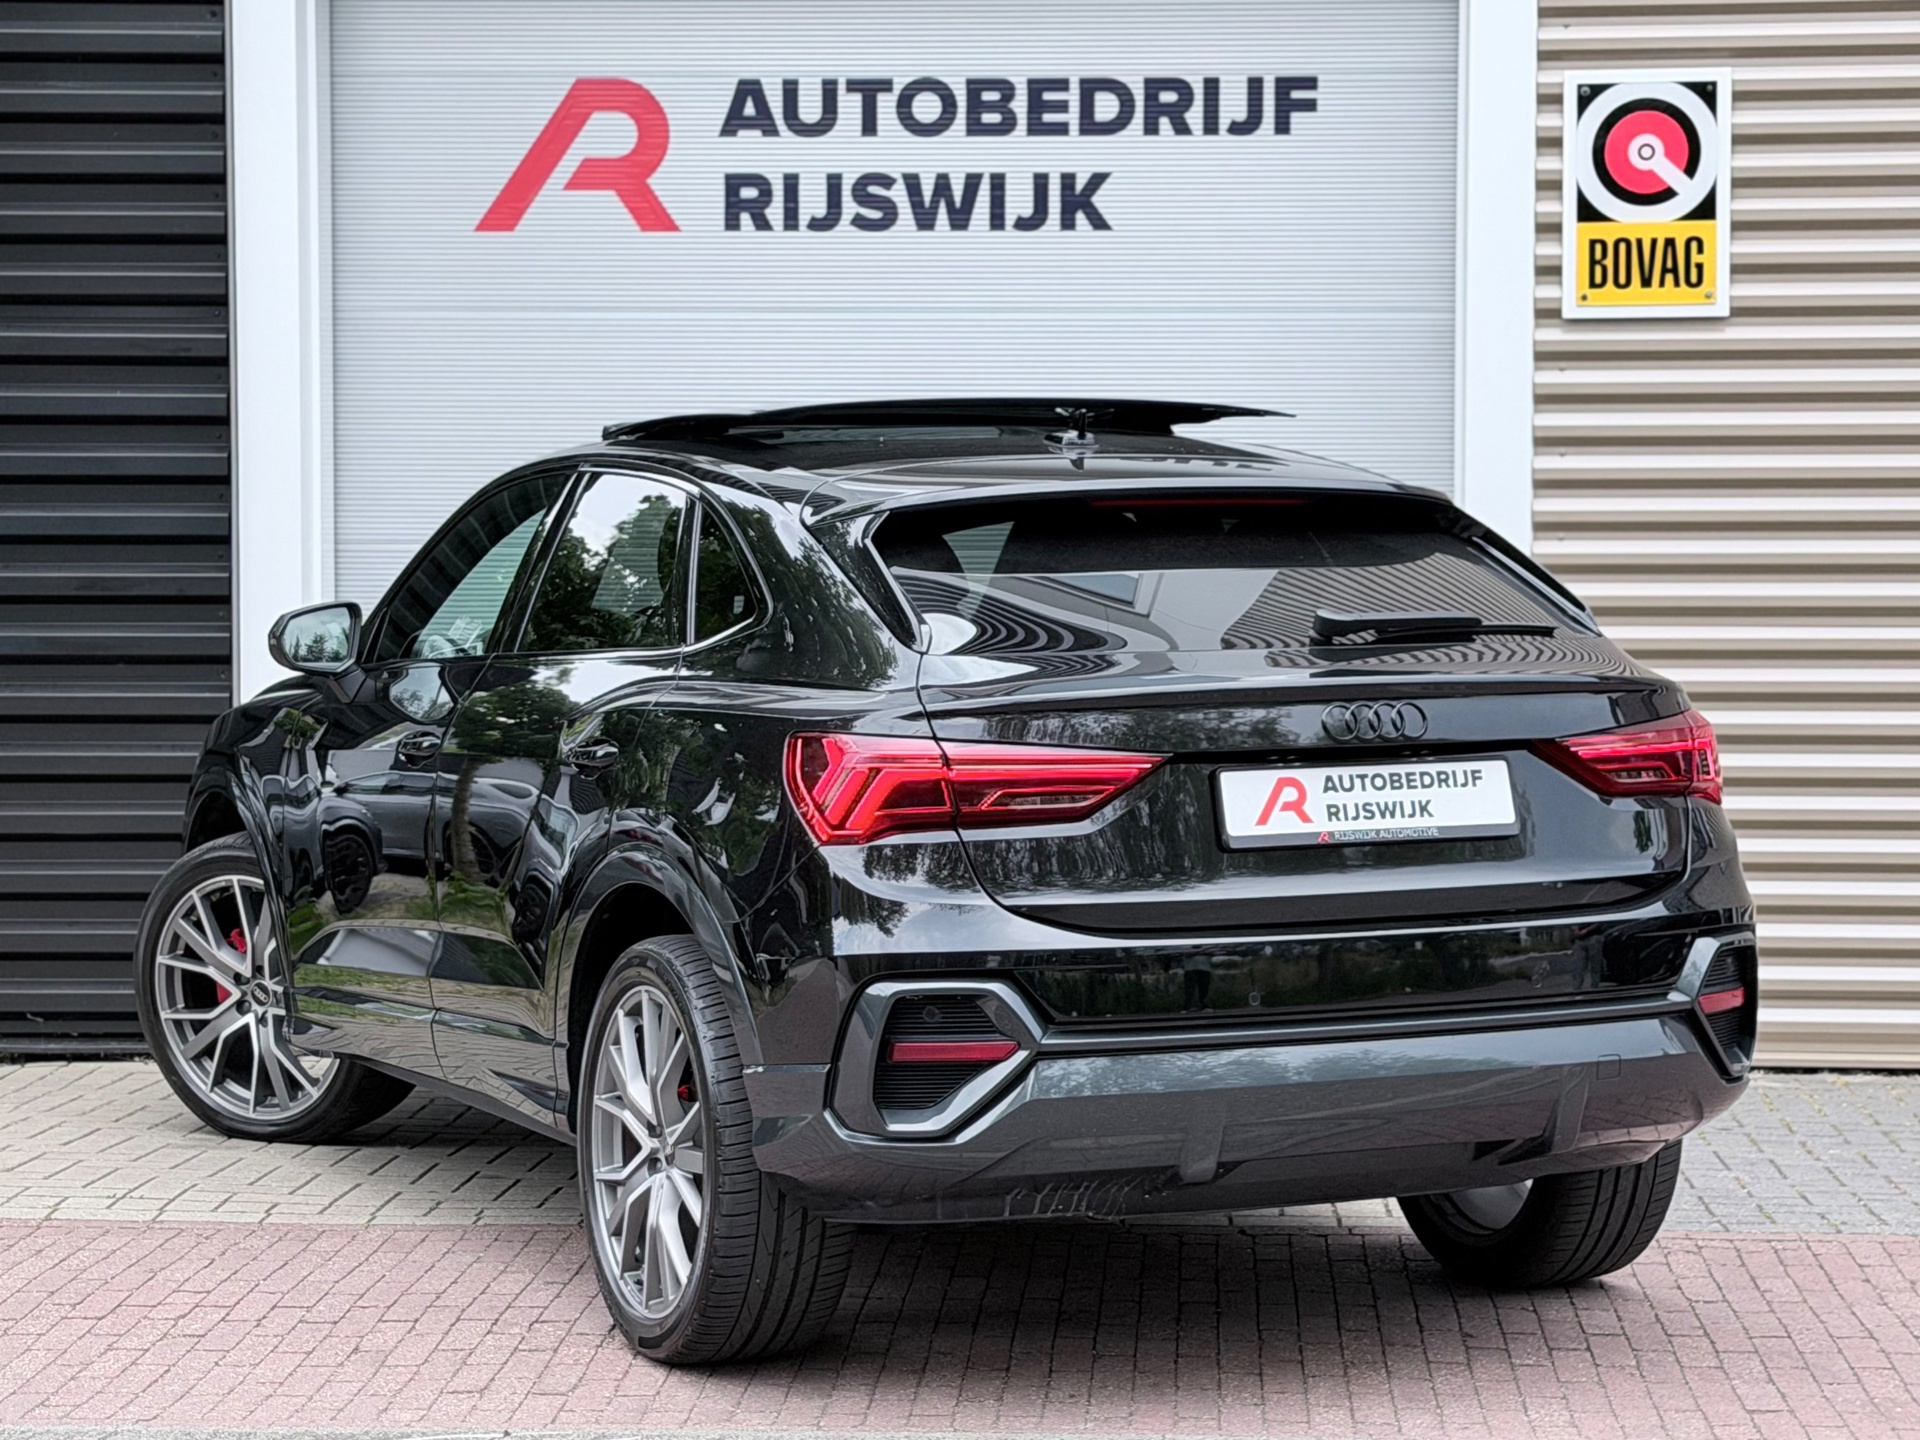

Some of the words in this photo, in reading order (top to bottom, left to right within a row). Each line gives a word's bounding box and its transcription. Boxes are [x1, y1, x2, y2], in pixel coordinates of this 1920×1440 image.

[718, 76, 1318, 137] AUTOBEDRIJF
[725, 172, 1113, 231] RIJSWIJK
[1588, 236, 1705, 289] BOVAG
[1322, 769, 1484, 794] AUTOBEDRIJF
[1326, 799, 1435, 822] RIJSWIJK
[1334, 830, 1377, 840] RIJSWIJK
[1379, 827, 1440, 838] AUTOMOTIVE
